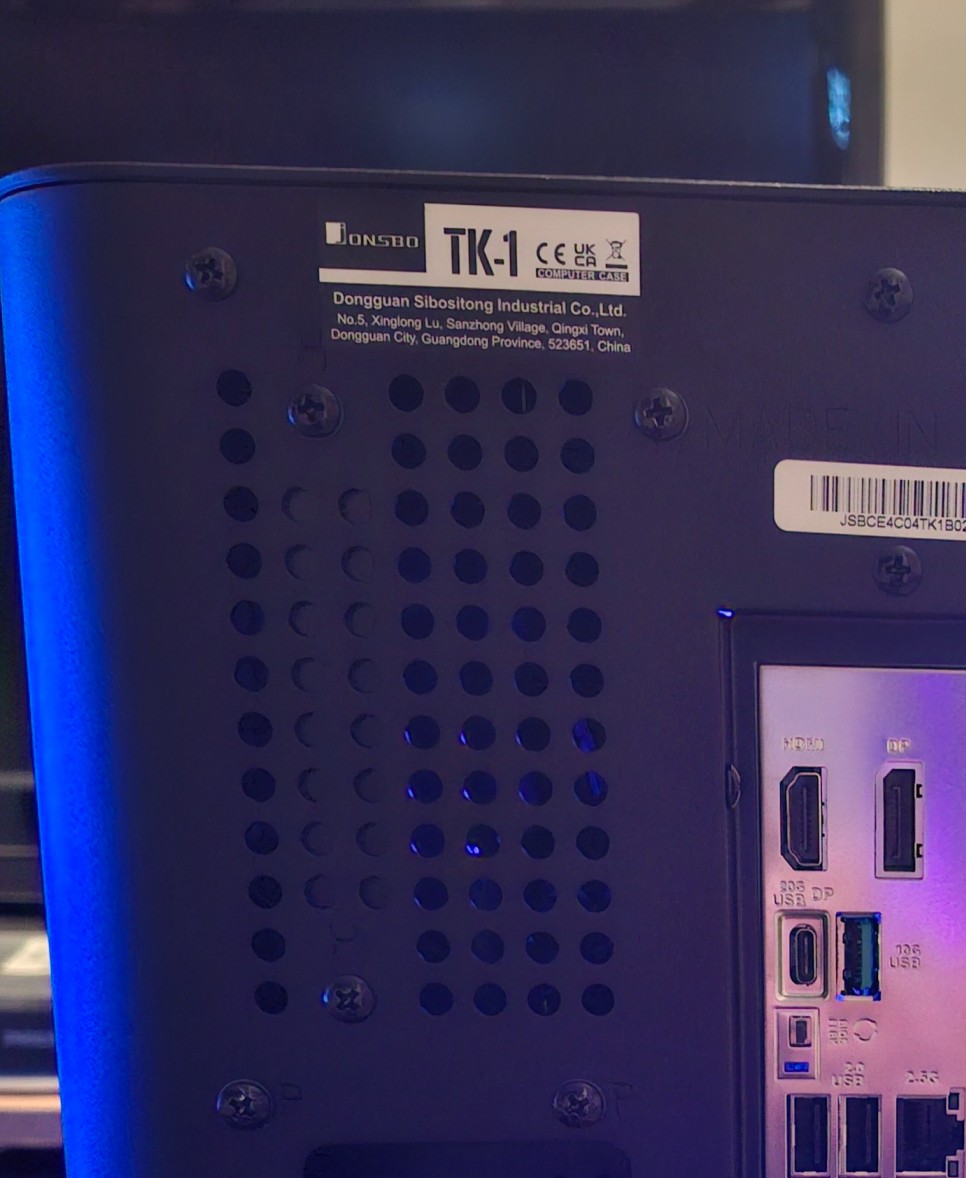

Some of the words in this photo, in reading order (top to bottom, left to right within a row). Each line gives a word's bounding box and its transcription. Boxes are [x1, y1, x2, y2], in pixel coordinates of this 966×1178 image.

[443, 227, 518, 277] TK-1
[537, 269, 595, 280] COMPUTER
[598, 271, 628, 282] CASE
[333, 291, 410, 310] Dongguan
[414, 295, 493, 314] Sibositong
[498, 298, 566, 315] Industrial
[337, 313, 368, 327] No.5,
[371, 315, 422, 331] Xinglong
[446, 318, 504, 333] Sanzhong
[507, 321, 549, 336] Village,
[552, 322, 588, 337] Qingxi
[591, 324, 625, 338] Town,
[331, 328, 390, 343] Dongguan
[394, 331, 419, 346] City,
[421, 333, 488, 349] Guangdong
[492, 335, 545, 350] Province,
[597, 340, 631, 353] China
[774, 893, 806, 907] USB
[812, 887, 834, 901] DP
[890, 957, 921, 969] USB
[832, 1074, 865, 1086] USB
